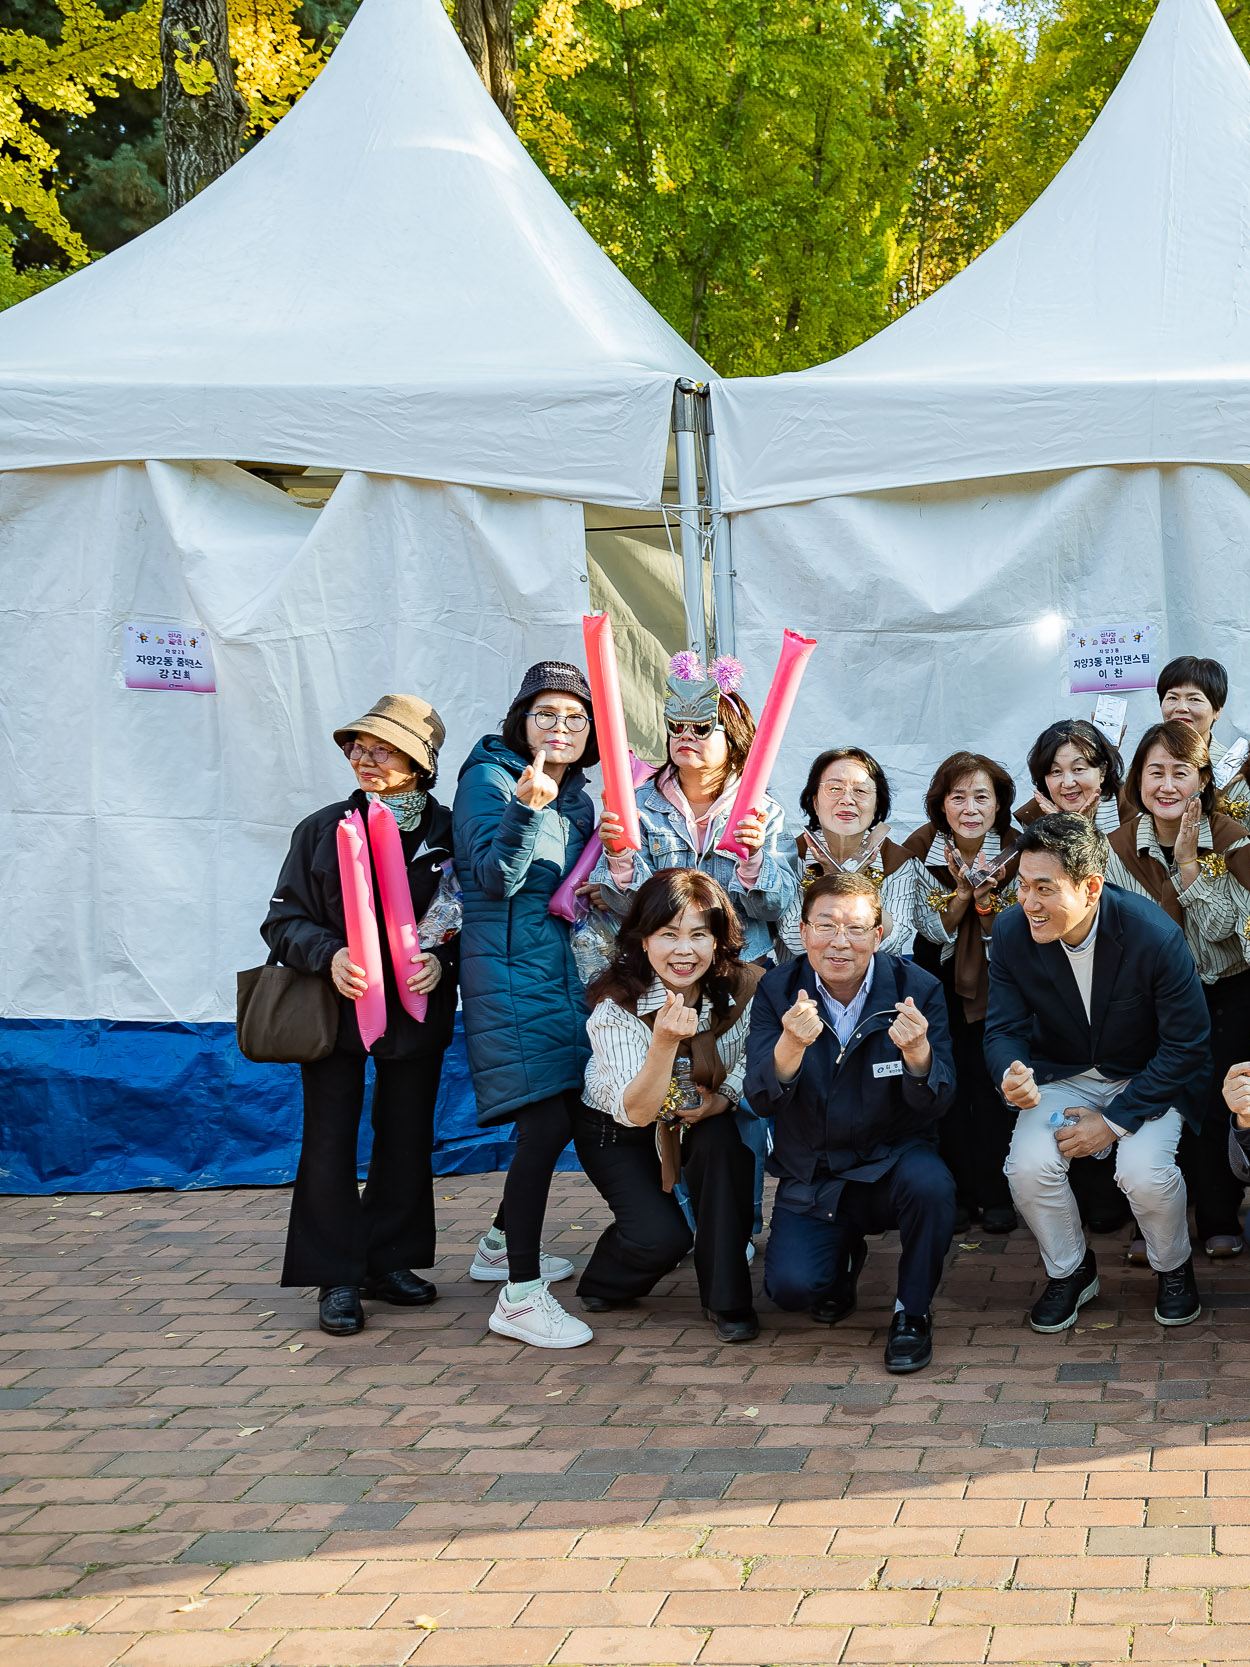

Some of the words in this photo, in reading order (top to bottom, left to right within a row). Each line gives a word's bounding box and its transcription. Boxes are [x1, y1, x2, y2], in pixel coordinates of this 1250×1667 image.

[136, 655, 174, 667] 자양2동
[1073, 656, 1103, 669] 자양3동
[1105, 653, 1150, 666] 라인댄스팀
